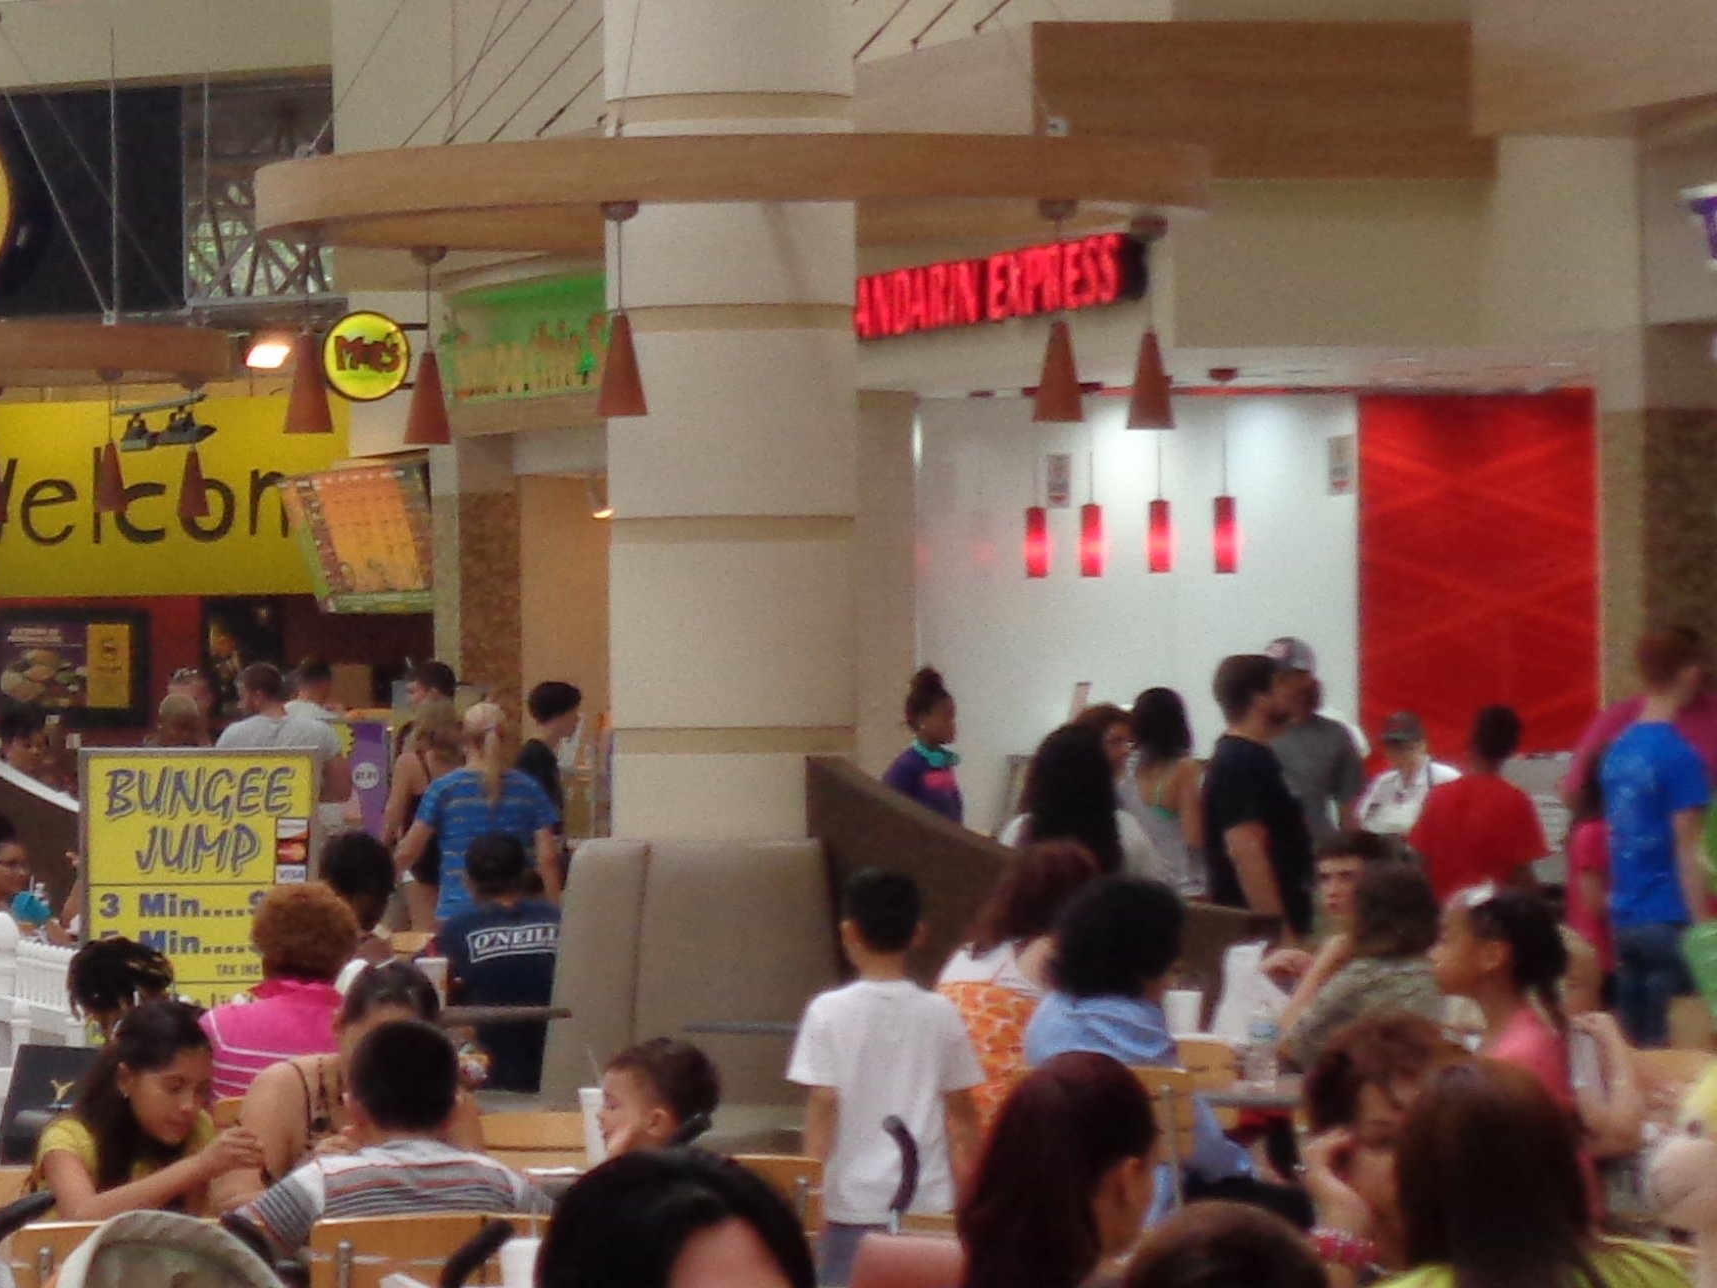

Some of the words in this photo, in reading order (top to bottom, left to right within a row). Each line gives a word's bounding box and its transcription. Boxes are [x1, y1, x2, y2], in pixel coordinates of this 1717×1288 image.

[854, 259, 985, 340] ANDARIN
[987, 232, 1123, 323] EXPRESS
[104, 764, 297, 826] BUNGEE
[134, 822, 262, 878] JUMP
[99, 893, 121, 918] 3
[240, 963, 262, 976] INC
